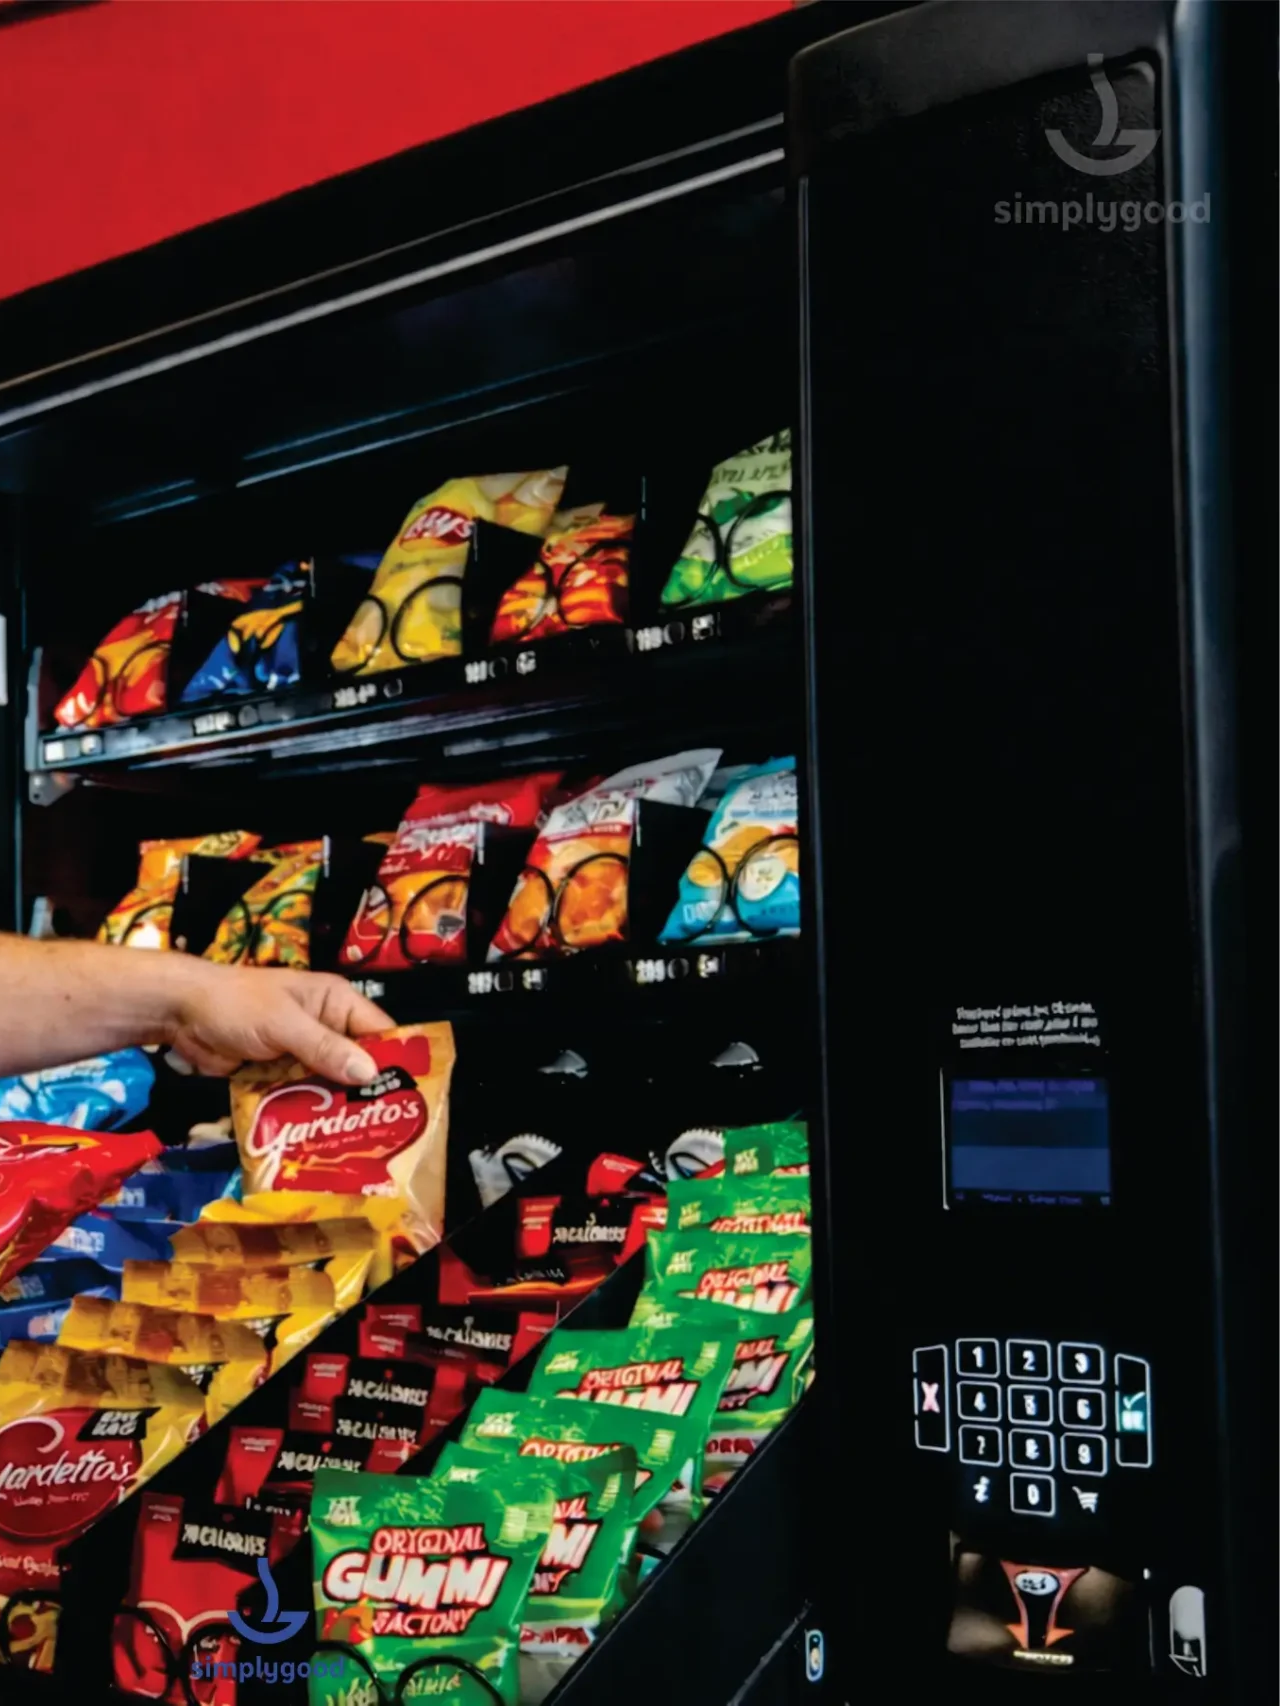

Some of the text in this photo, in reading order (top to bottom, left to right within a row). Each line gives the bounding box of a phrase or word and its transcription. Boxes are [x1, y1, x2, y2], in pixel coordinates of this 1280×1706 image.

[372, 1527, 486, 1553] ORIGINAL
[325, 1552, 509, 1610] GUMMI
[372, 1608, 477, 1635] FACTORY
